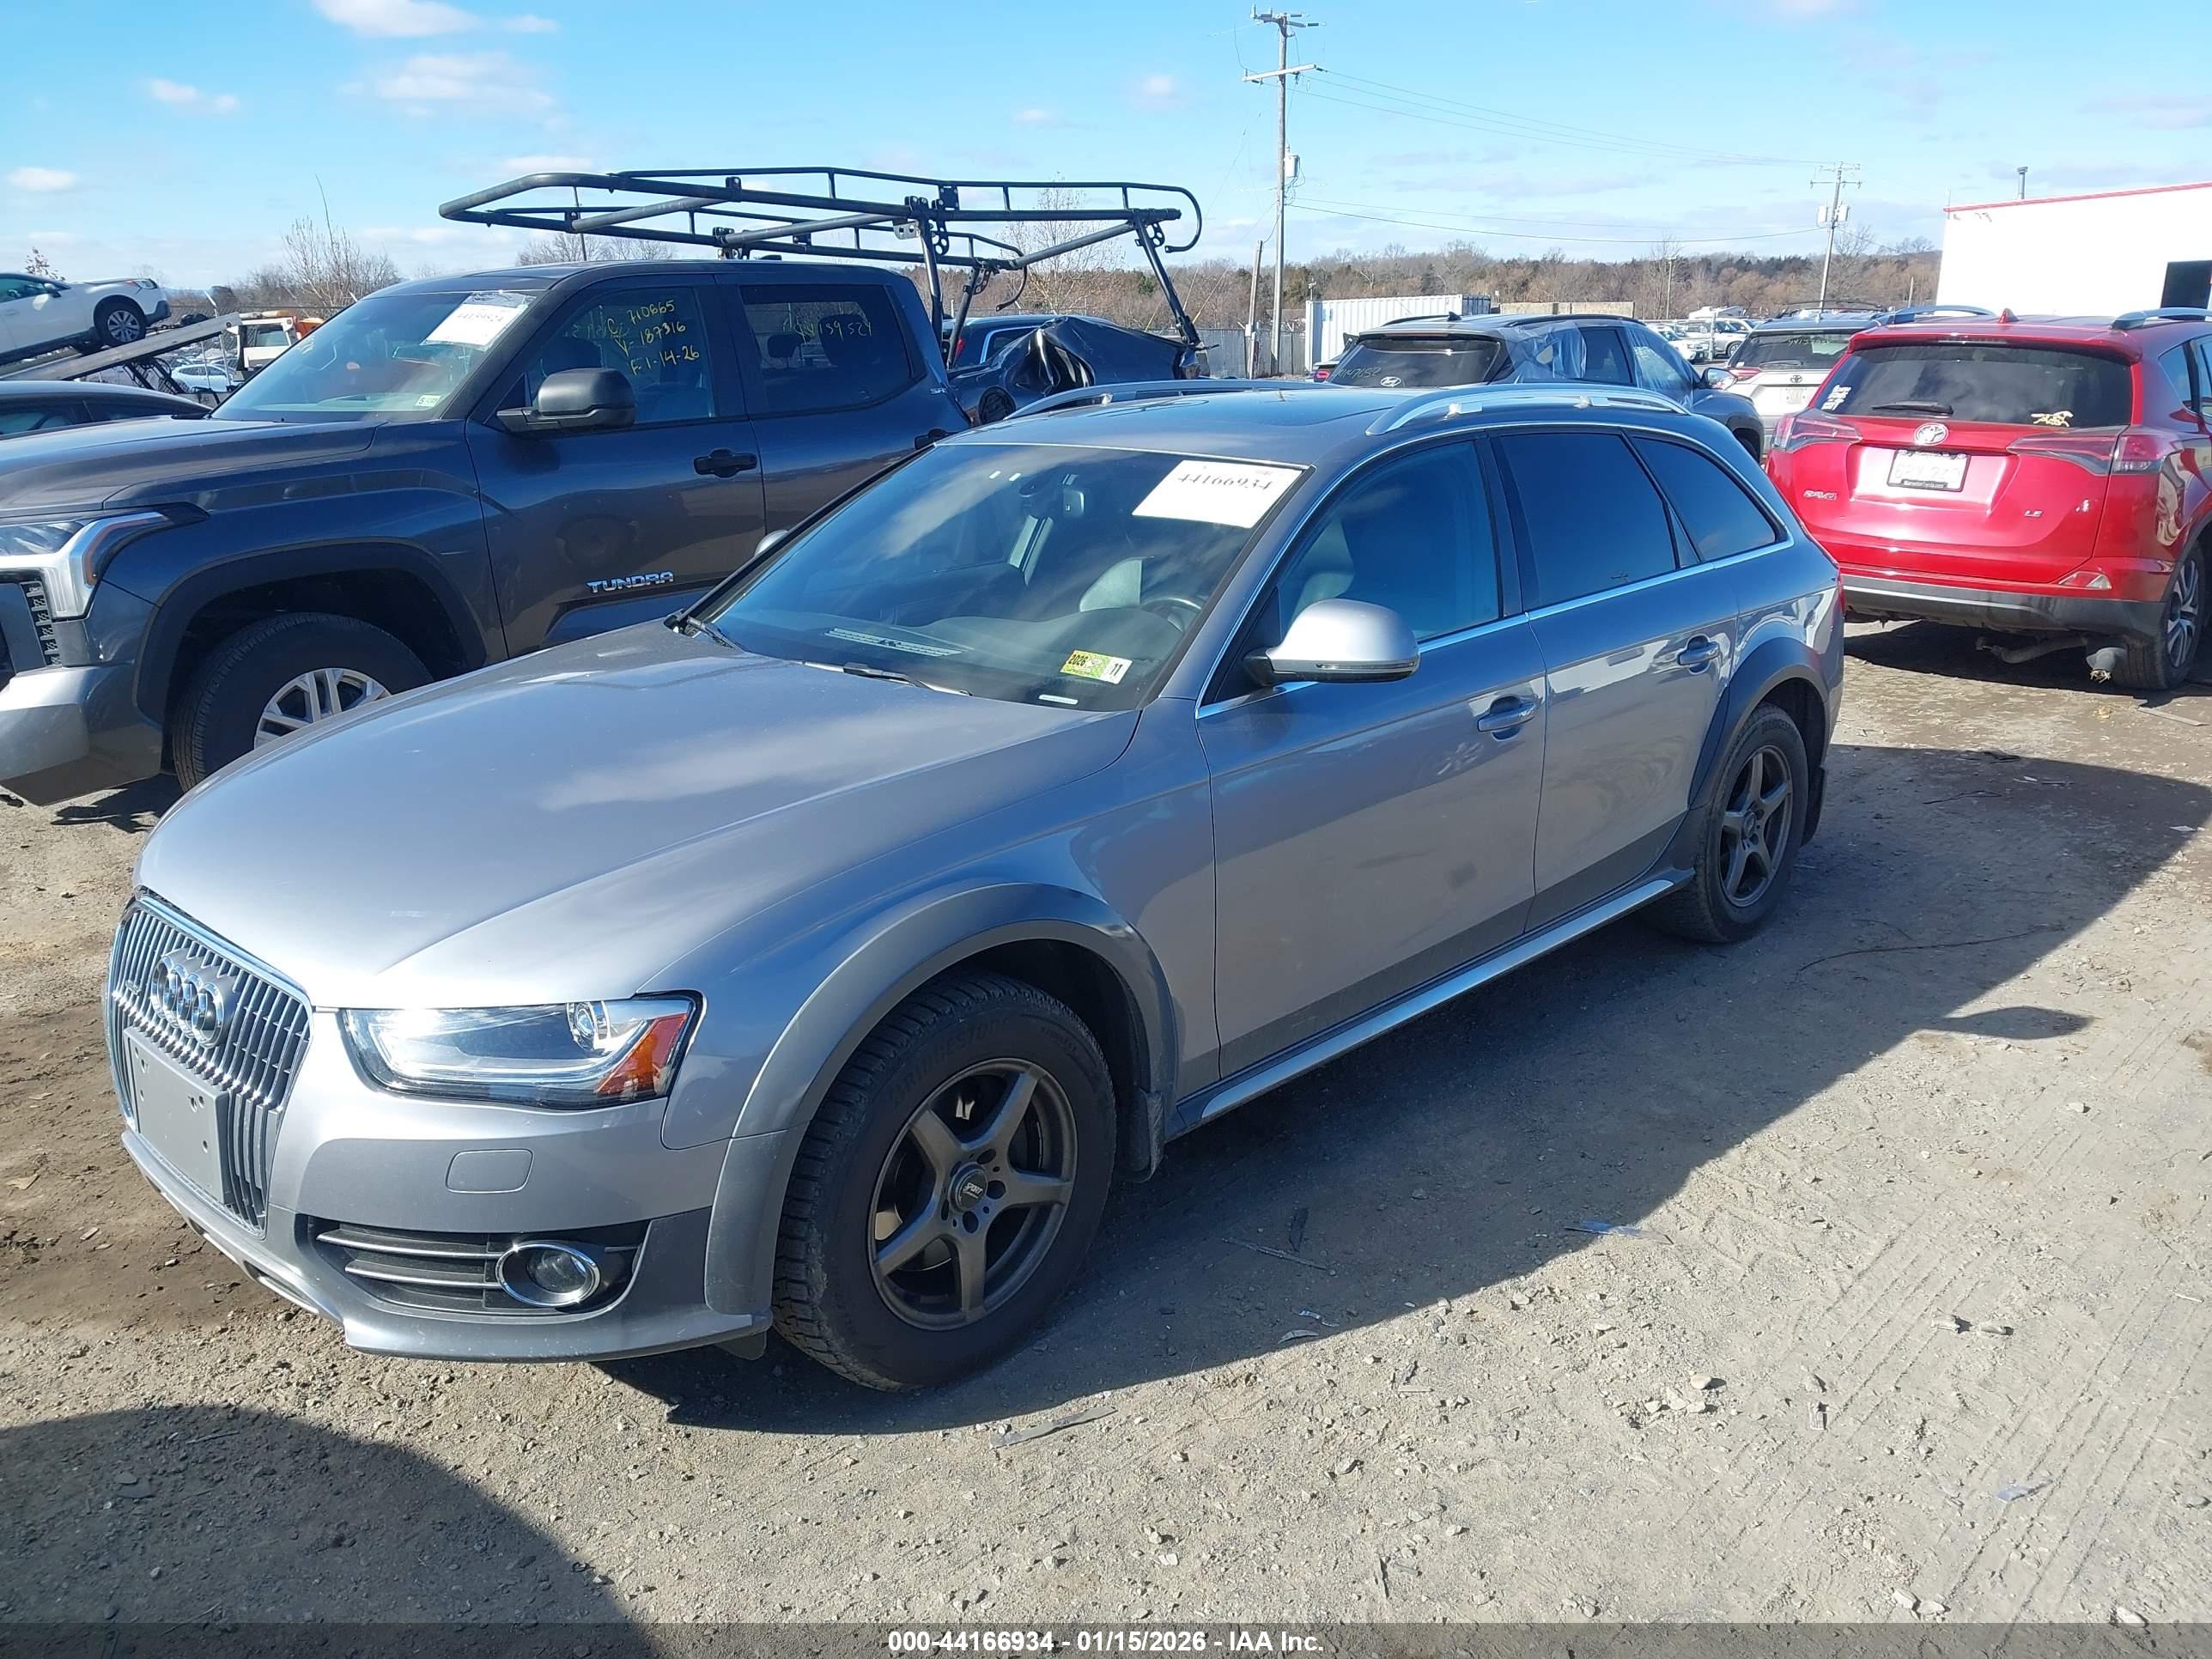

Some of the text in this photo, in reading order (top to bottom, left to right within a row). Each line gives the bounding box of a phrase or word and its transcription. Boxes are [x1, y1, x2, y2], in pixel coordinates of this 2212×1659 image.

[627, 301, 674, 325] 710665
[640, 321, 686, 344] 187316
[1178, 473, 1273, 490] 44166934
[586, 571, 674, 593] TUNDRA
[1067, 653, 1089, 667] 2026
[1110, 663, 1123, 677] 11
